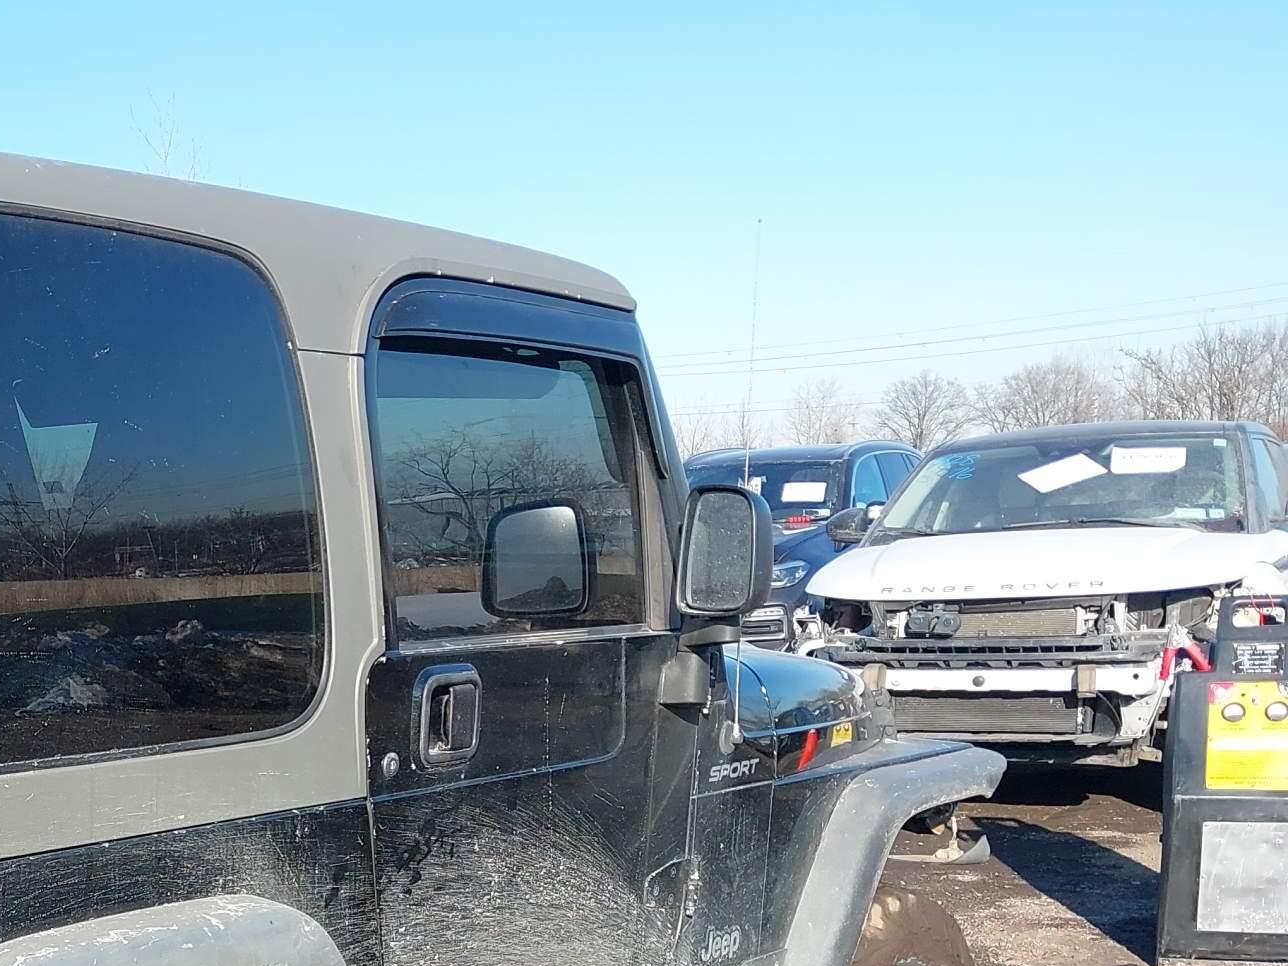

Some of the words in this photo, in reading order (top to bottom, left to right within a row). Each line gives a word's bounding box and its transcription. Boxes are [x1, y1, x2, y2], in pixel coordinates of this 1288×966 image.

[880, 585, 977, 595] RANGE
[1000, 580, 1104, 591] ROVER
[708, 758, 760, 783] SPORT
[701, 927, 740, 962] Jeep
